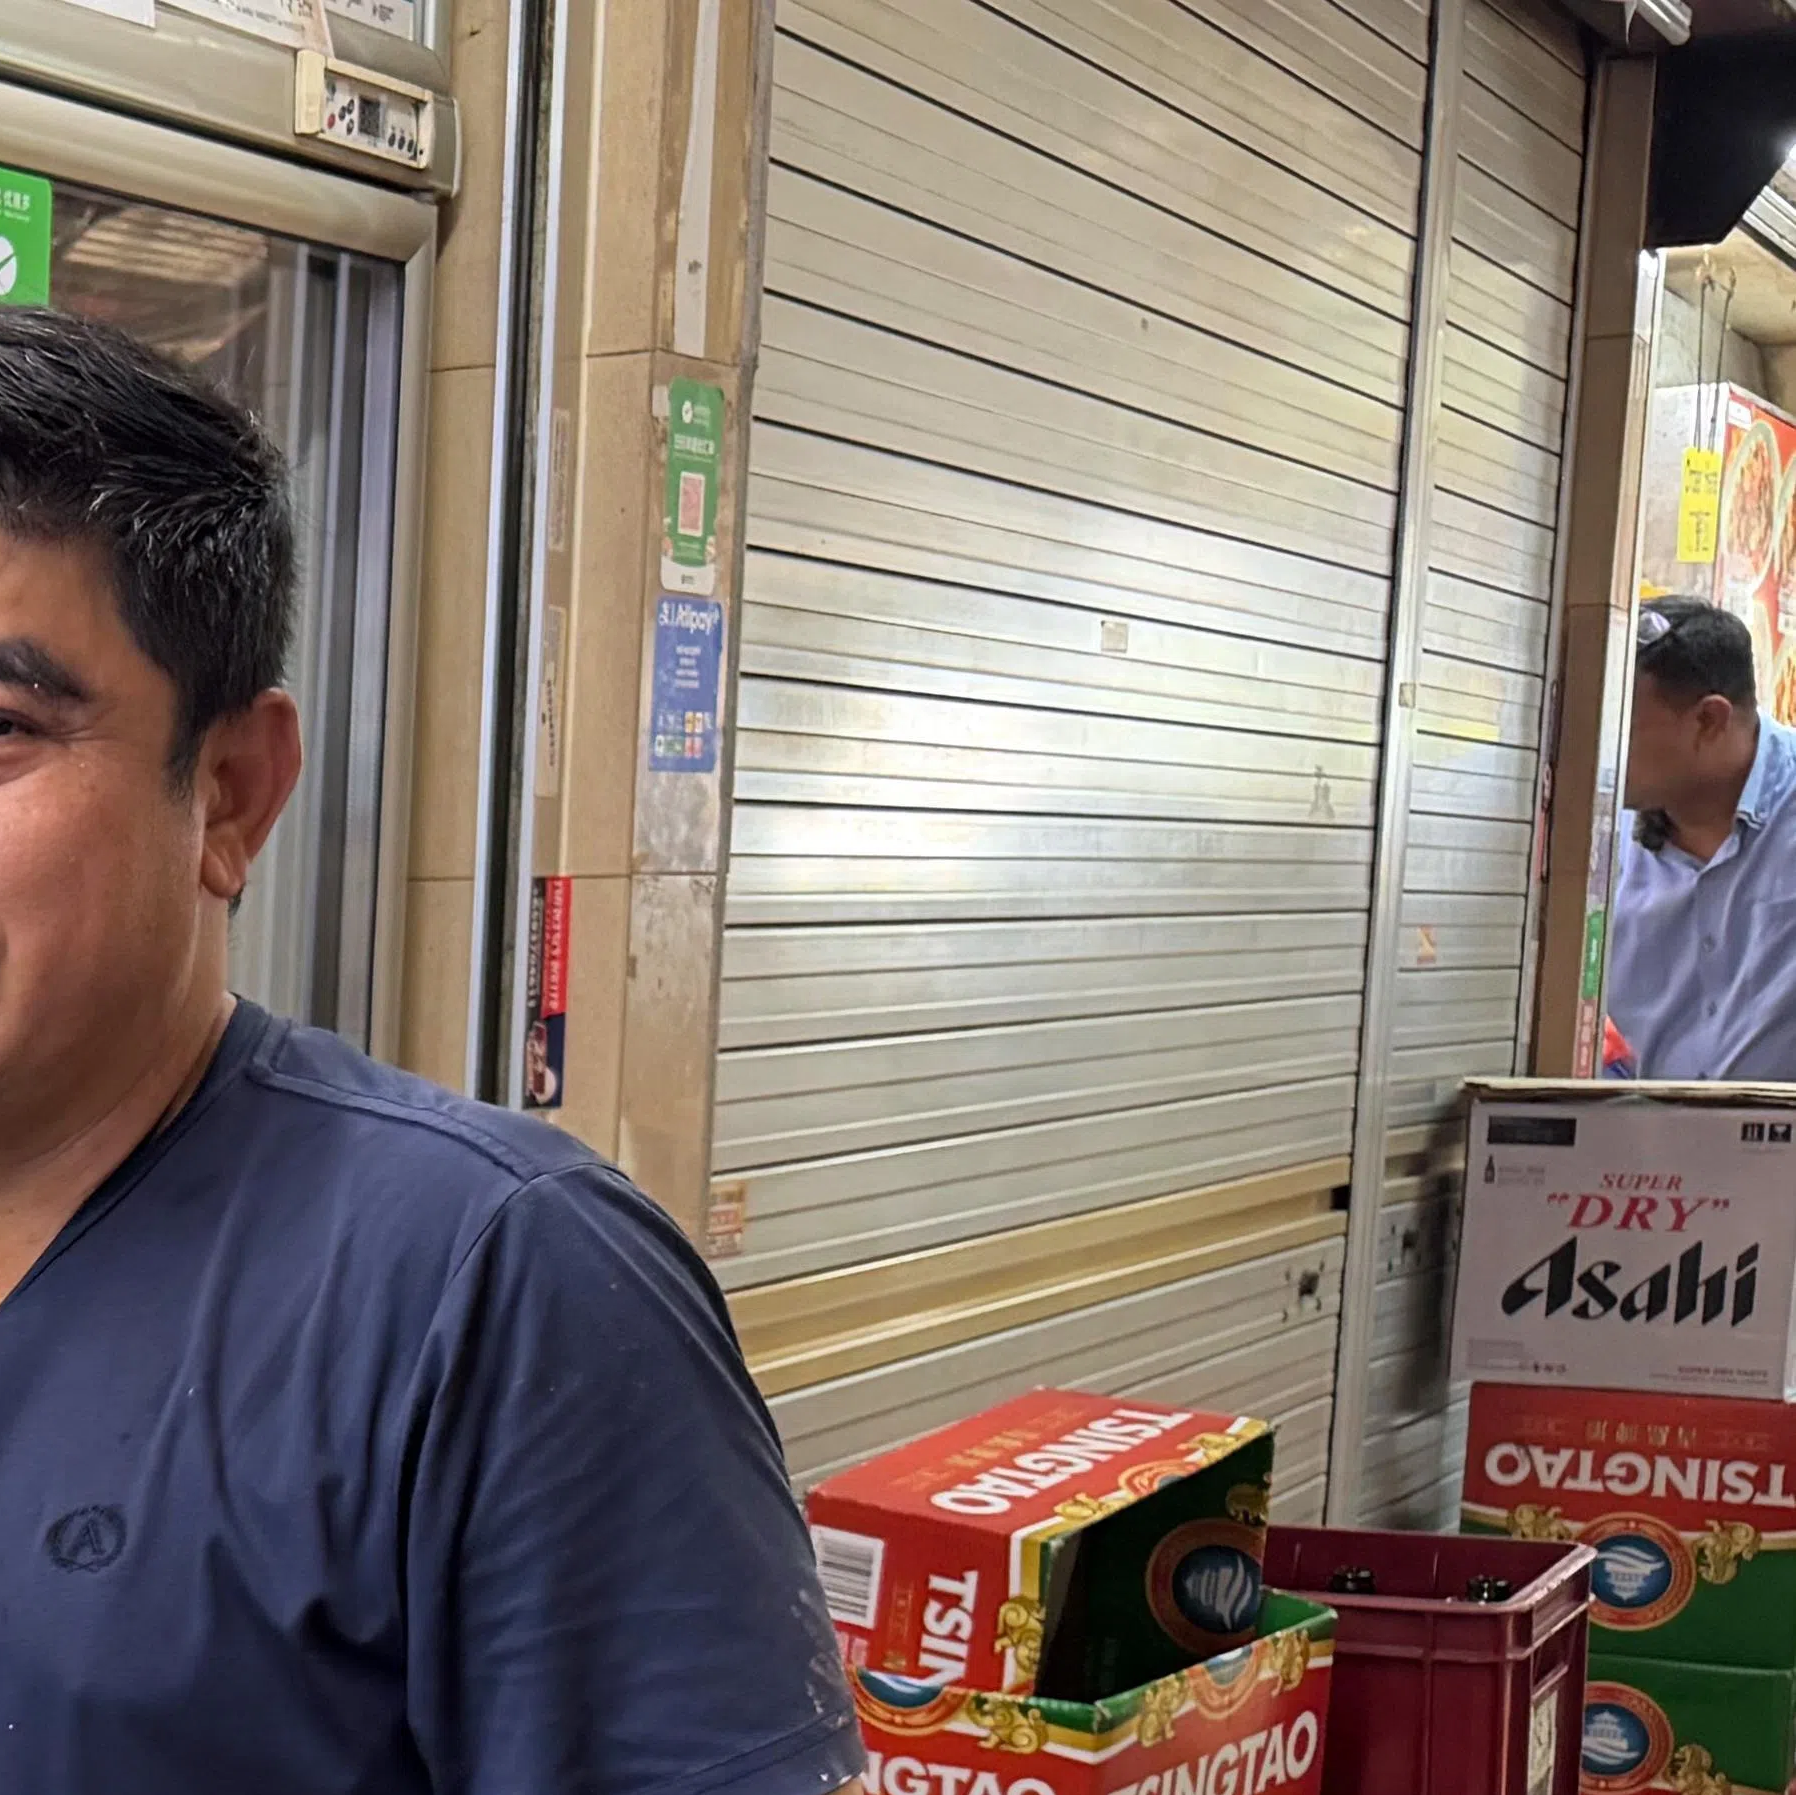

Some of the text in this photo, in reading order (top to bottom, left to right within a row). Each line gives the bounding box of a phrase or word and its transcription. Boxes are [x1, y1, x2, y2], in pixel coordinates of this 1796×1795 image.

[1599, 1173, 1683, 1191] SUPER
[1501, 1236, 1759, 1328] Asahi
[931, 1408, 1193, 1514] TSINGTAO
[1484, 1442, 1796, 1510] TSINGTAO
